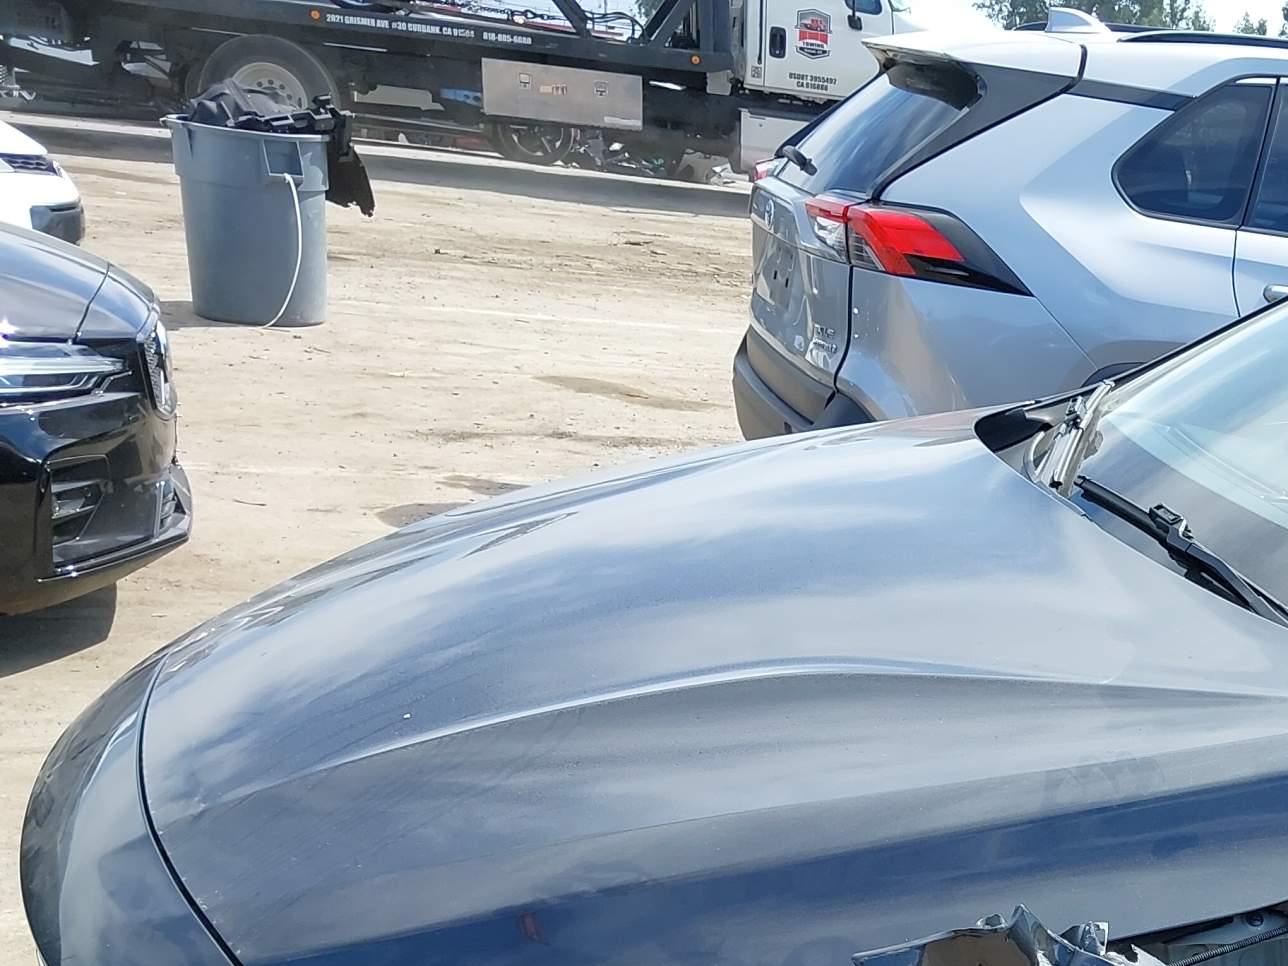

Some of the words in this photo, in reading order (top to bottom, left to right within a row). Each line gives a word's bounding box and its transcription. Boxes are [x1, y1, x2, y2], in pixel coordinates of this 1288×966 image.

[442, 26, 452, 36] CA
[802, 41, 825, 49] TOWING
[788, 72, 809, 81] USDOT
